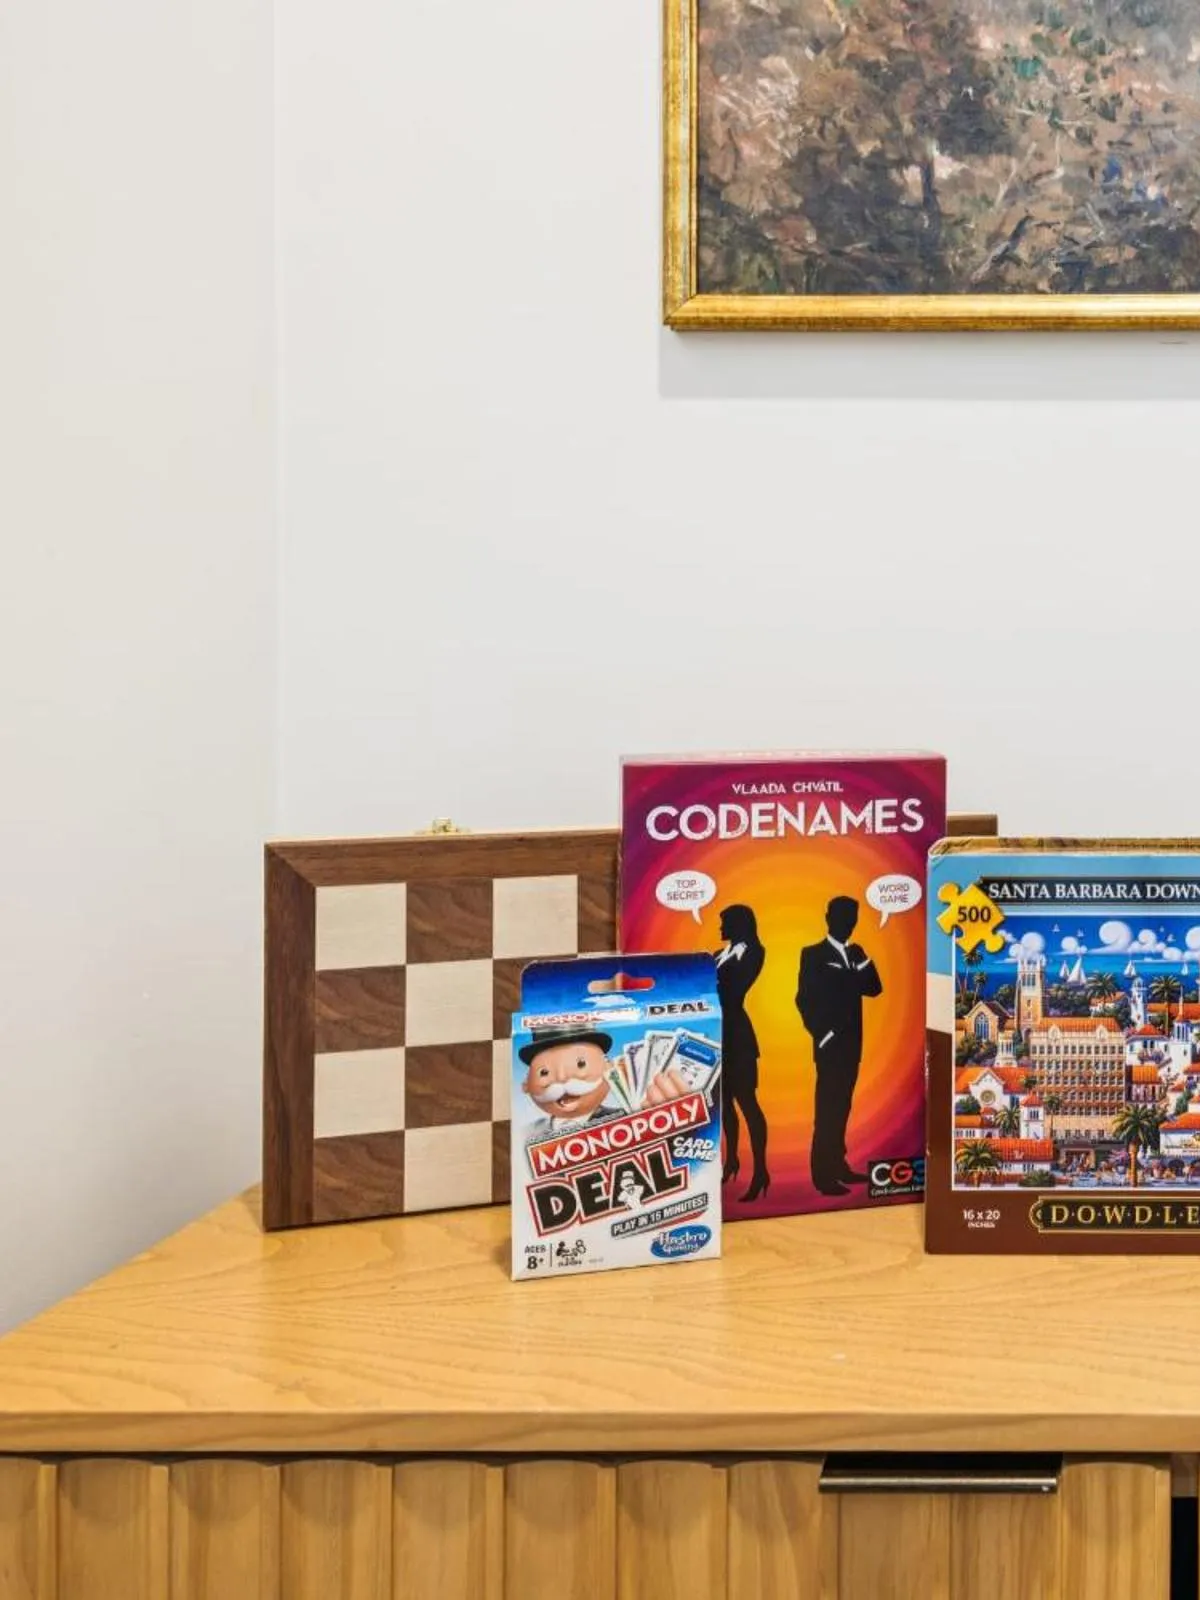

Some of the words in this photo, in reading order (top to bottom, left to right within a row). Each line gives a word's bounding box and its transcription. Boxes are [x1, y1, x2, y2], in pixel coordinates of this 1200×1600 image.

[732, 783, 786, 794] VLAADA
[645, 798, 924, 841] CODENAMES
[675, 879, 697, 889] TOP
[878, 883, 910, 894] WORD
[989, 882, 1050, 899] SANTA
[1055, 882, 1141, 899] BARBARA
[666, 890, 705, 901] SECRET
[879, 894, 909, 904] GAME
[957, 906, 991, 923] 500
[650, 1002, 711, 1016] DEAL
[537, 1098, 700, 1172] MONOPOLY
[672, 1136, 714, 1151] CARD
[672, 1147, 716, 1161] GAME
[532, 1150, 684, 1230] DEAL
[613, 1218, 637, 1235] PLAY
[663, 1195, 707, 1217] MINUTES!
[963, 1210, 974, 1220] 16
[985, 1210, 1000, 1220] 20
